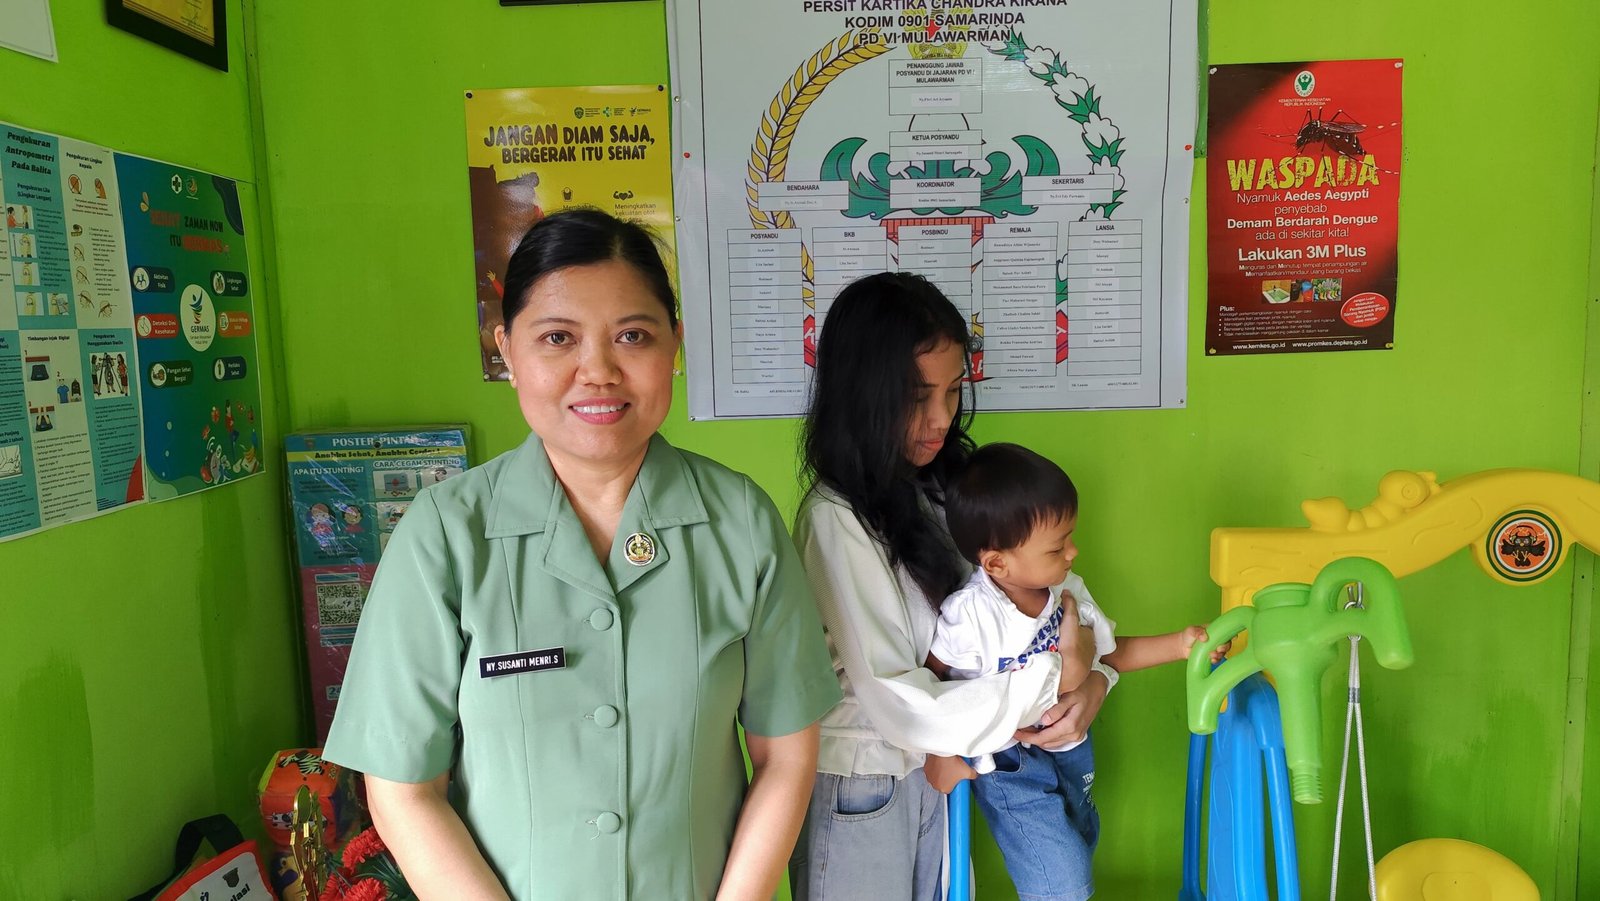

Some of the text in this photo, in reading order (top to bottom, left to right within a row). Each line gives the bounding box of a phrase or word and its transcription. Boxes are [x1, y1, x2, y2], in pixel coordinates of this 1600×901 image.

[803, 0, 856, 12] PERSIT
[860, 0, 927, 11] KARTIKA
[930, 0, 1004, 9] CHANDRA
[845, 12, 1025, 28] KODIM 0901 SAMARINDA
[859, 29, 1011, 45] PD VI MULAWARMAN
[7, 131, 51, 148] Pengukuran
[483, 123, 656, 147] JANGAN DIAM SAJA,
[930, 133, 960, 141] POSYANDU
[5, 145, 55, 162] Antropometri
[502, 145, 648, 164] BERGERAK ITU SEHAT
[11, 160, 52, 175] Pada Balita
[1226, 153, 1380, 191] WASPADA
[1051, 177, 1085, 185] SEKERTARIS
[786, 184, 820, 192] BENDAHARA
[1236, 187, 1370, 206] Nyamuk Aedes Aegypti
[614, 203, 656, 211] Meningkatkan
[1274, 203, 1328, 217] penyebab
[184, 216, 208, 231] ZAMAN
[1095, 223, 1115, 231] LANSIA
[1227, 213, 1379, 229] Demam Berdarah Dengue
[1009, 226, 1032, 234] REMAJA
[1255, 226, 1350, 241] ada di sekitar kita!
[169, 234, 182, 247] ITU
[1238, 244, 1367, 262] Lakukan 3M Plus
[1239, 264, 1266, 272] Menguras
[190, 325, 210, 333] GERMAS
[1232, 338, 1368, 351] www.kemkes.go.id www.promkes.depkes.go.id
[332, 437, 374, 447] POSTER
[373, 458, 460, 468] CARA CEGAH STUNTING
[293, 468, 310, 476] APA
[529, 655, 559, 666] MENRI.S
